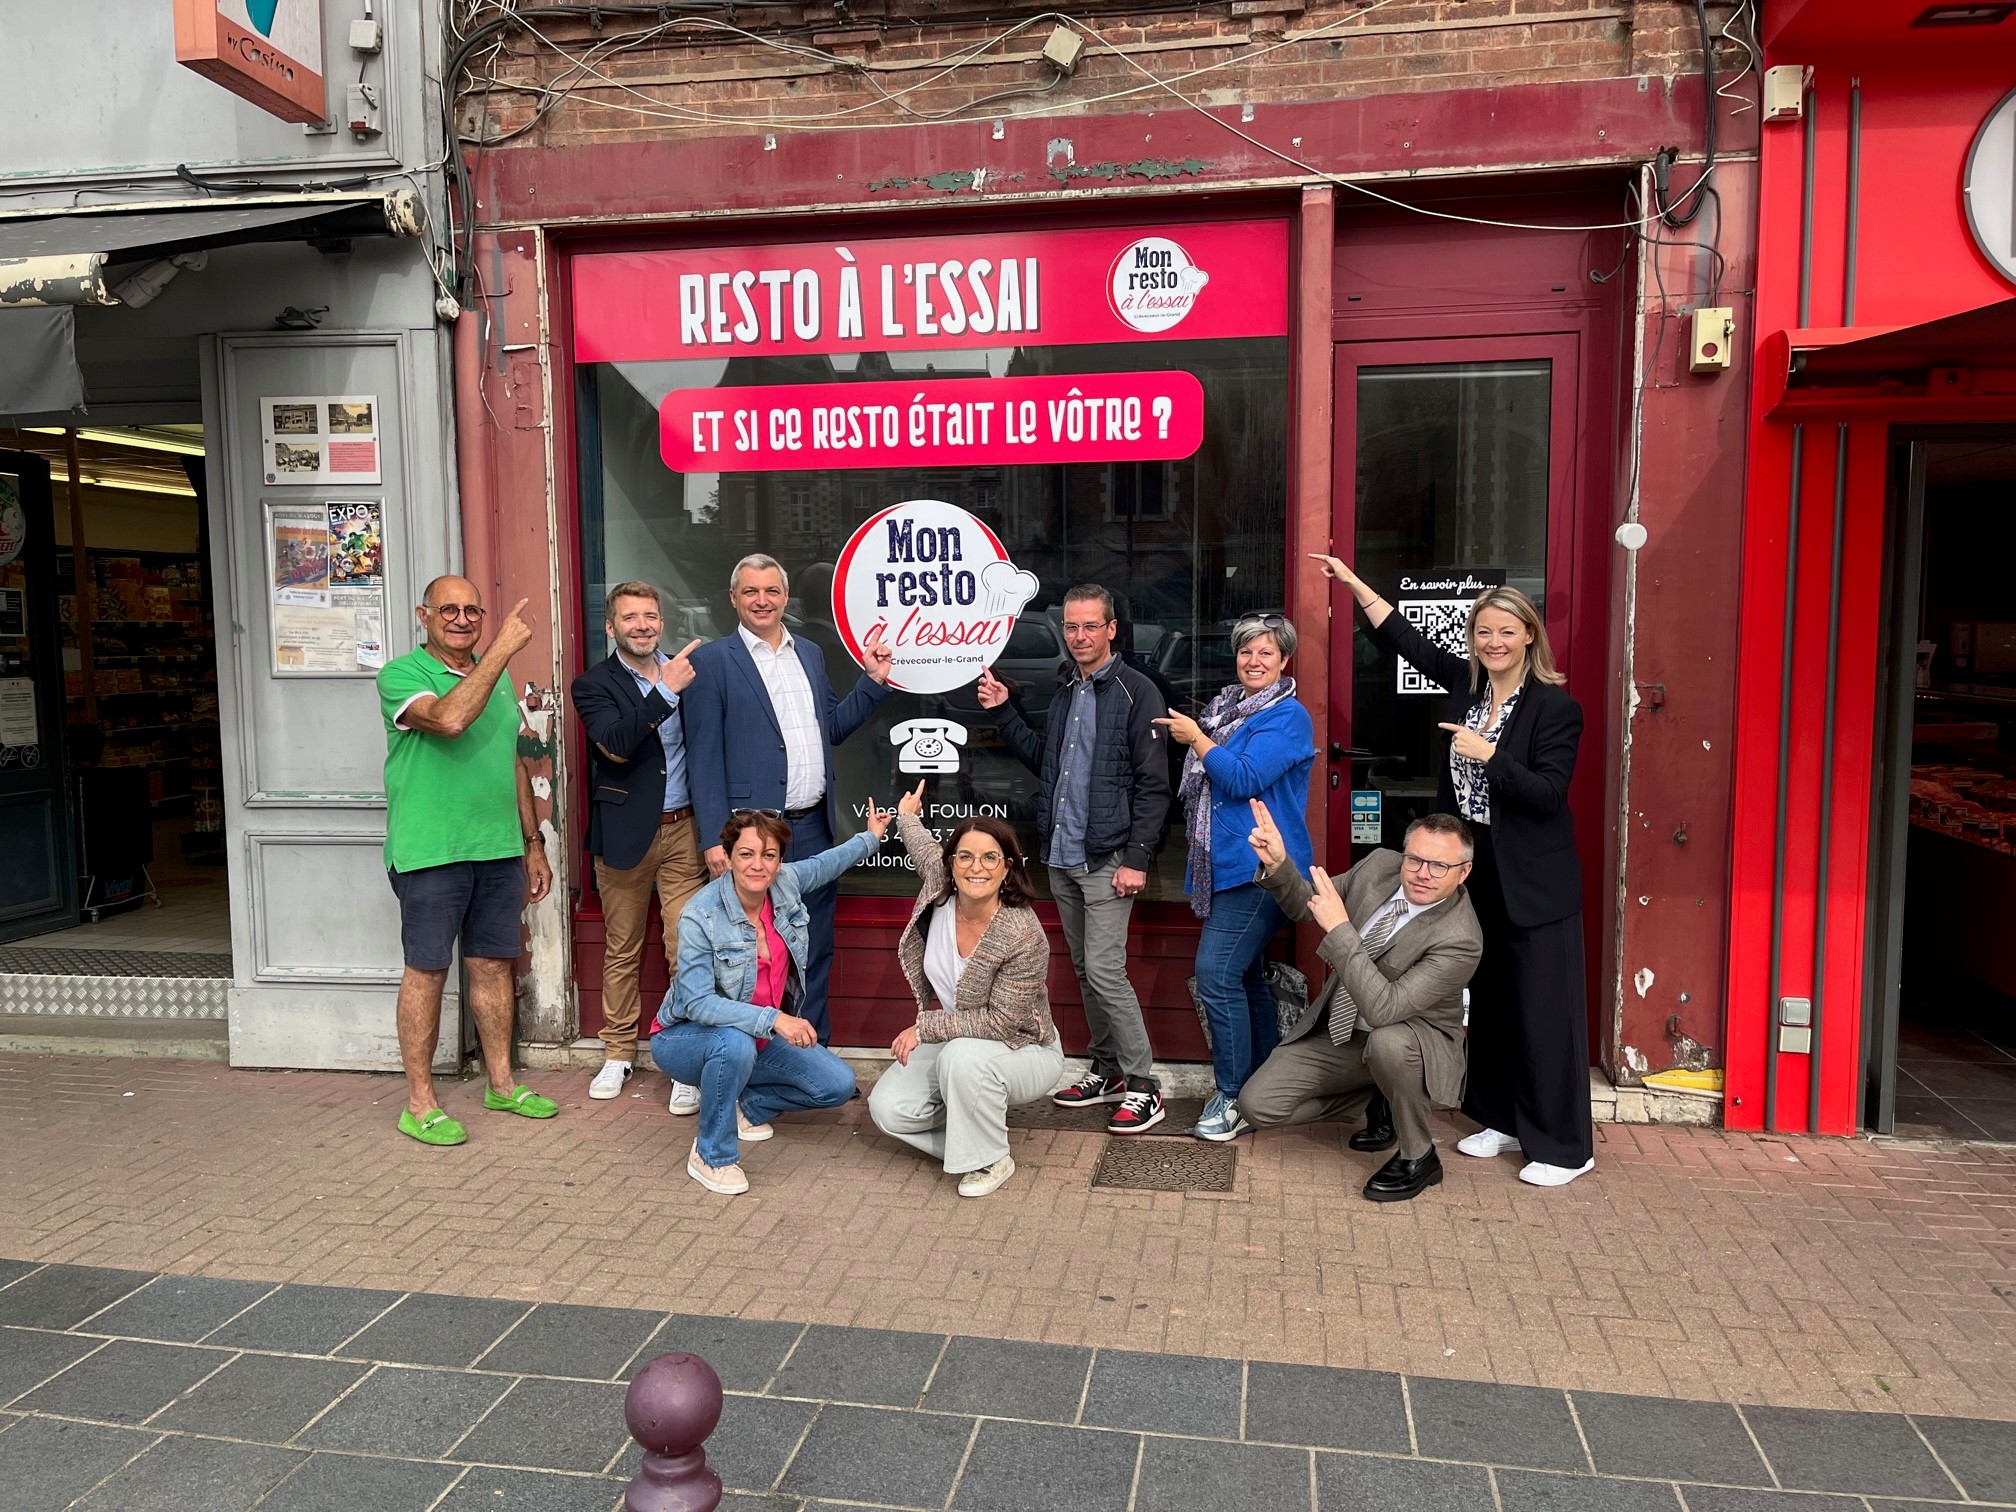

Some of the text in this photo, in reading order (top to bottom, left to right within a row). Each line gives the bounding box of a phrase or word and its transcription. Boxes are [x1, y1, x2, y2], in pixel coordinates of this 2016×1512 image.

[227, 32, 294, 82] by Casino
[1135, 247, 1172, 268] Mon
[1129, 268, 1178, 290] resto
[680, 247, 1038, 344] RESTO À L'ESSAI
[1121, 294, 1134, 310] à
[692, 410, 724, 453] ET
[733, 409, 759, 452] SI
[1152, 396, 1172, 439] ?
[329, 504, 368, 522] EXPO
[886, 518, 963, 563] Mon
[875, 563, 976, 607] resto
[1400, 577, 1419, 590] En
[1420, 578, 1458, 590] savoir
[895, 606, 1002, 647] l'essai
[891, 654, 984, 666] Crèvecoeur-le-Grand
[930, 804, 1007, 819] FOULON
